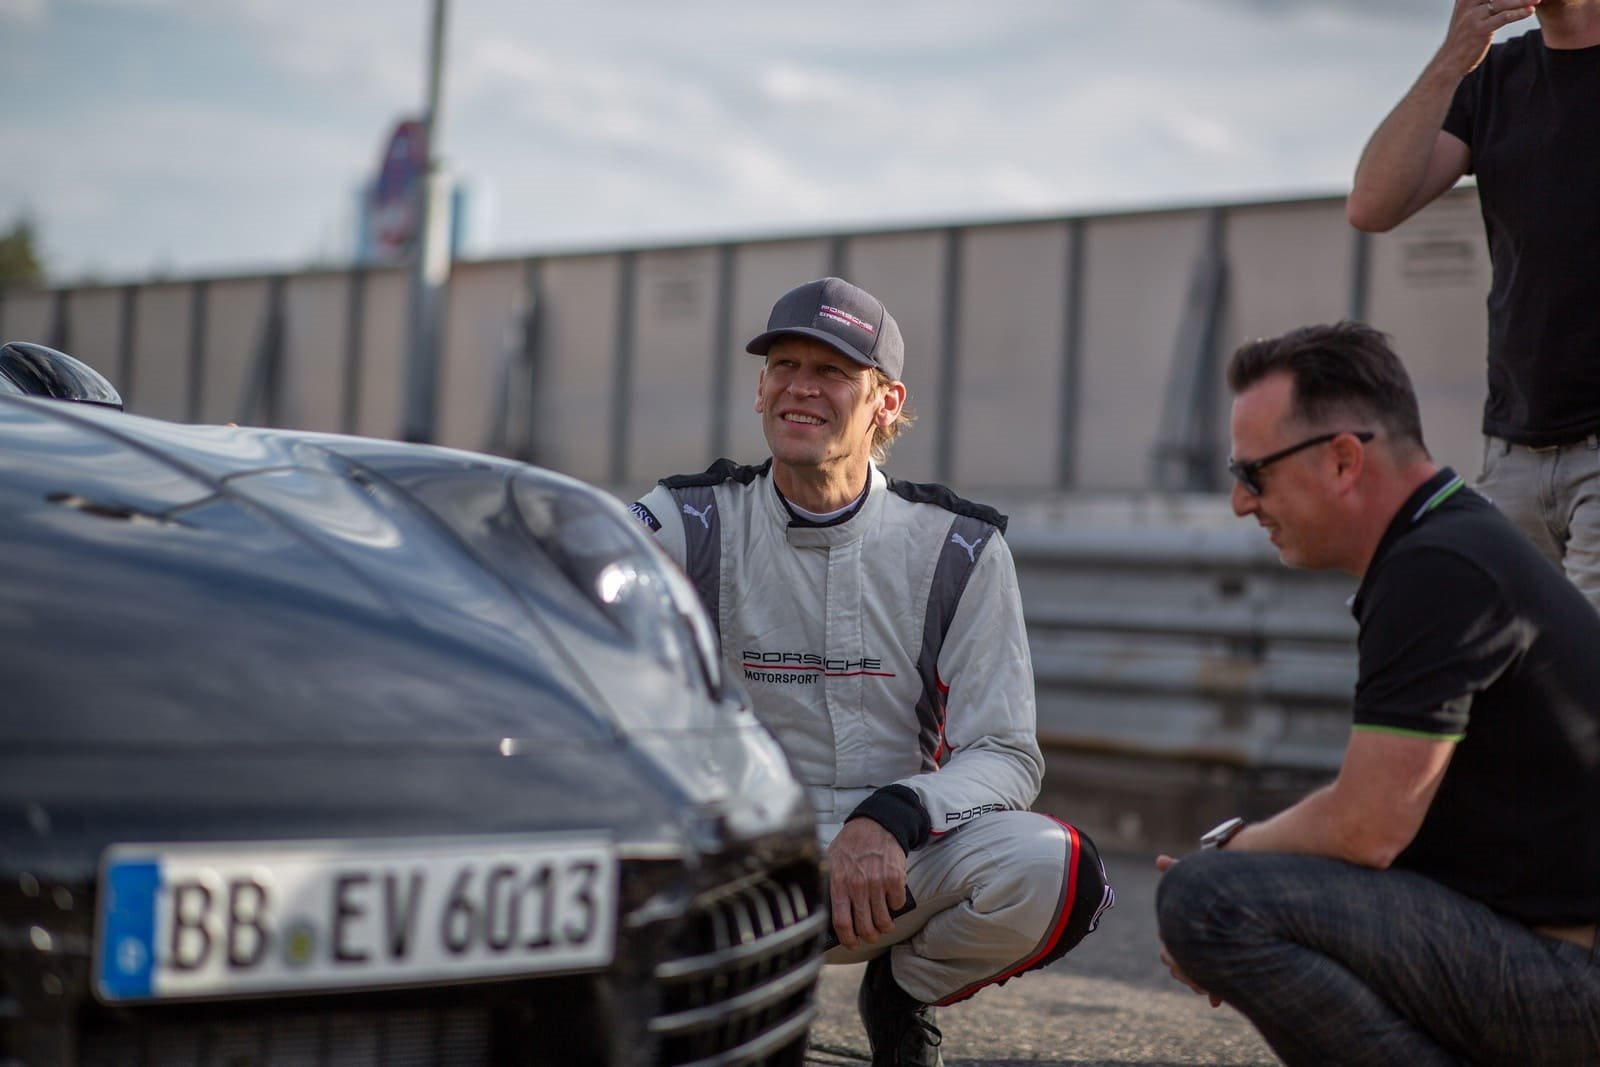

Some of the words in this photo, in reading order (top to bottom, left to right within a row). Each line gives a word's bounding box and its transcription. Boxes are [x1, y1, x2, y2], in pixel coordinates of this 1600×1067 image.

[821, 304, 873, 330] PORSCHE
[743, 651, 881, 671] PORSCHE
[744, 669, 819, 685] MOTORSPORT
[169, 880, 269, 972] BB
[331, 873, 425, 964] EV
[439, 861, 598, 955] 6013
